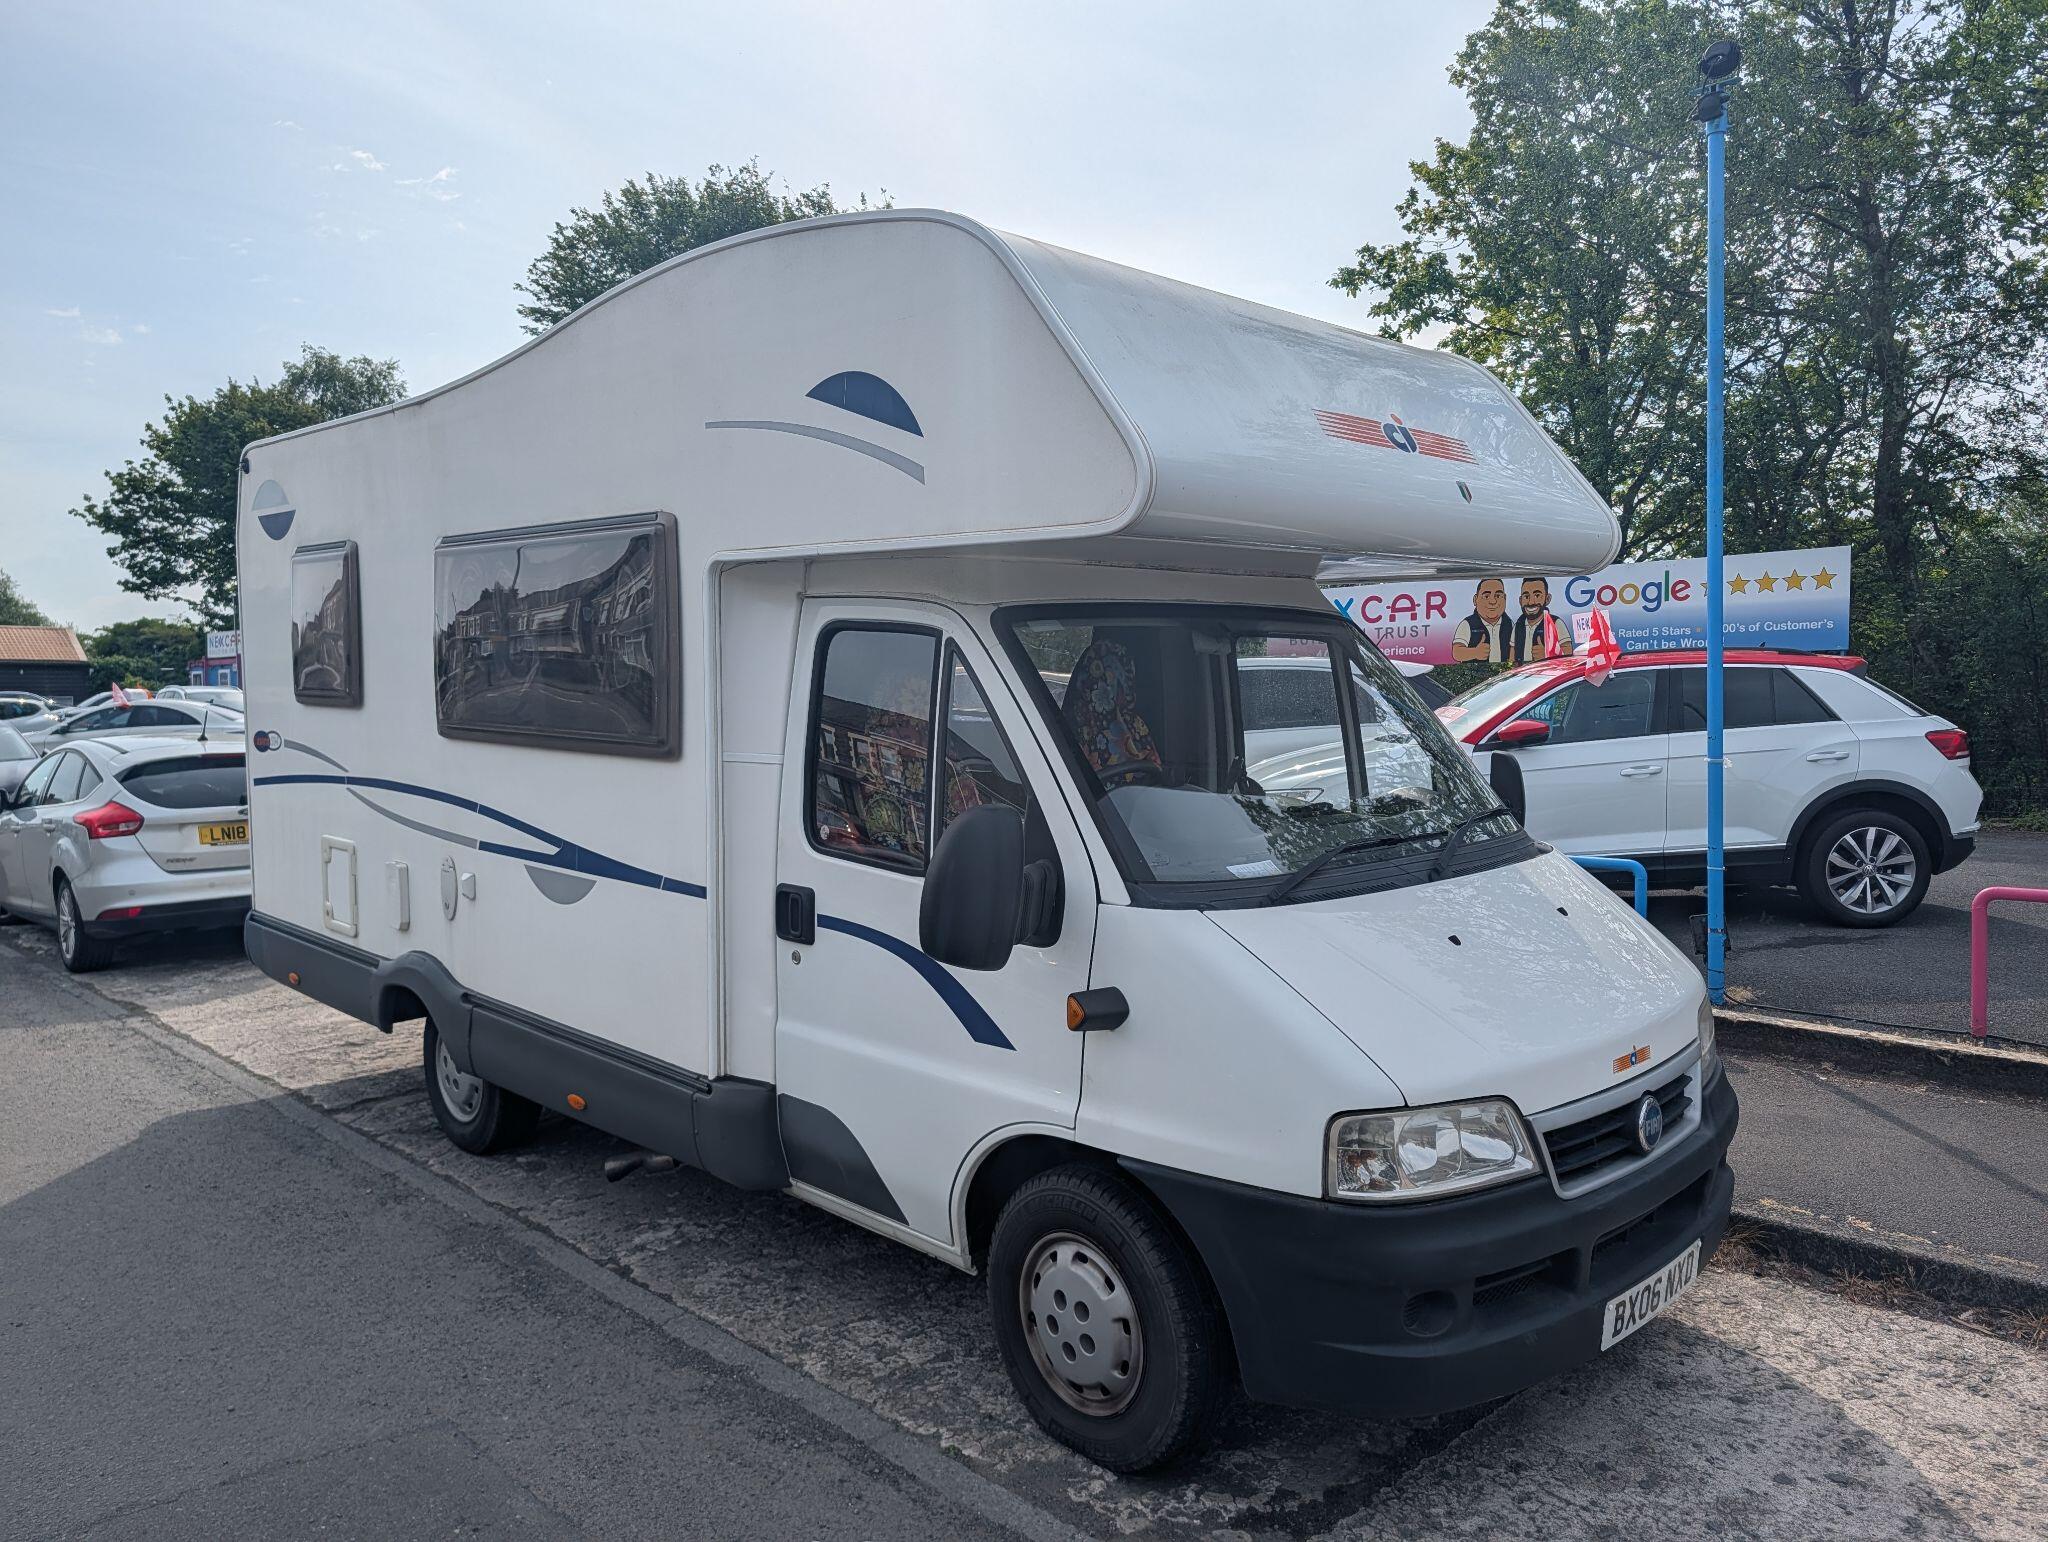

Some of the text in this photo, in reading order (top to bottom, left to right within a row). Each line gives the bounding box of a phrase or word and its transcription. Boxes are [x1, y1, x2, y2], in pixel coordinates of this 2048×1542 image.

[1565, 570, 1691, 612] Google
[1374, 625, 1431, 639] TRUST
[1618, 628, 1649, 638] Rated
[1652, 627, 1659, 637] 5
[1661, 627, 1691, 636] Stars
[1748, 622, 1761, 632] of
[1763, 619, 1834, 631] Customer's
[1626, 640, 1658, 650] Can't
[1661, 639, 1677, 648] be
[209, 826, 246, 841] LN18
[1645, 1114, 1662, 1137] FIAT
[1611, 1250, 1695, 1339] BX06 NXD
